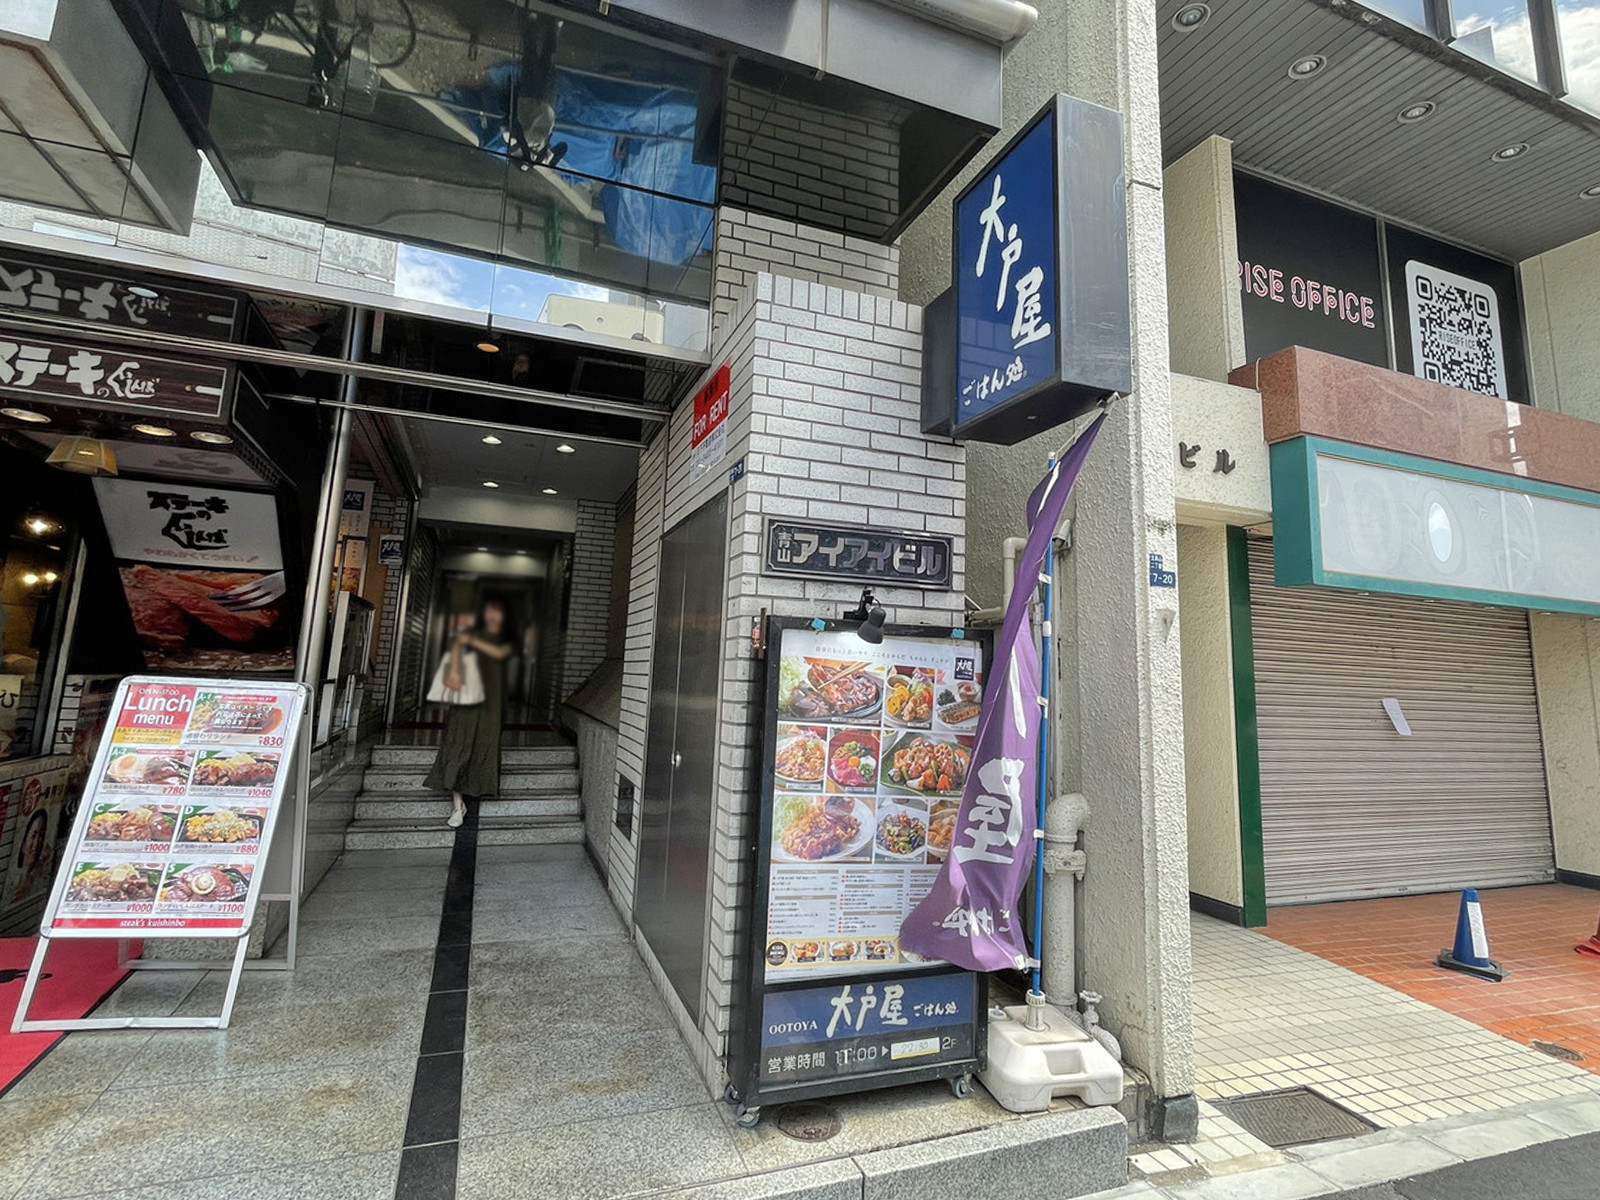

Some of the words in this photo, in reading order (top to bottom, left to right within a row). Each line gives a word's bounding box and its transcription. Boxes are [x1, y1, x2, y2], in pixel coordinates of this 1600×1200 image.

[975, 174, 1051, 350] 大戸屋
[1290, 276, 1376, 329] OFFICE
[693, 413, 707, 442] FOR
[709, 390, 729, 425] RENT
[1178, 441, 1236, 475] ビル
[777, 532, 791, 563] 青山
[792, 532, 942, 577] アイアイビル
[1152, 572, 1173, 584] 7-20
[124, 692, 193, 713] Lunch
[133, 713, 175, 726] menu
[95, 803, 104, 813] C
[184, 806, 194, 815] D
[76, 863, 84, 872] E
[169, 864, 177, 873] S
[826, 985, 908, 1038] 大戸屋
[769, 1020, 818, 1035] OOTOYA
[768, 1052, 826, 1074] 営業時間
[942, 1036, 957, 1050] 2F
